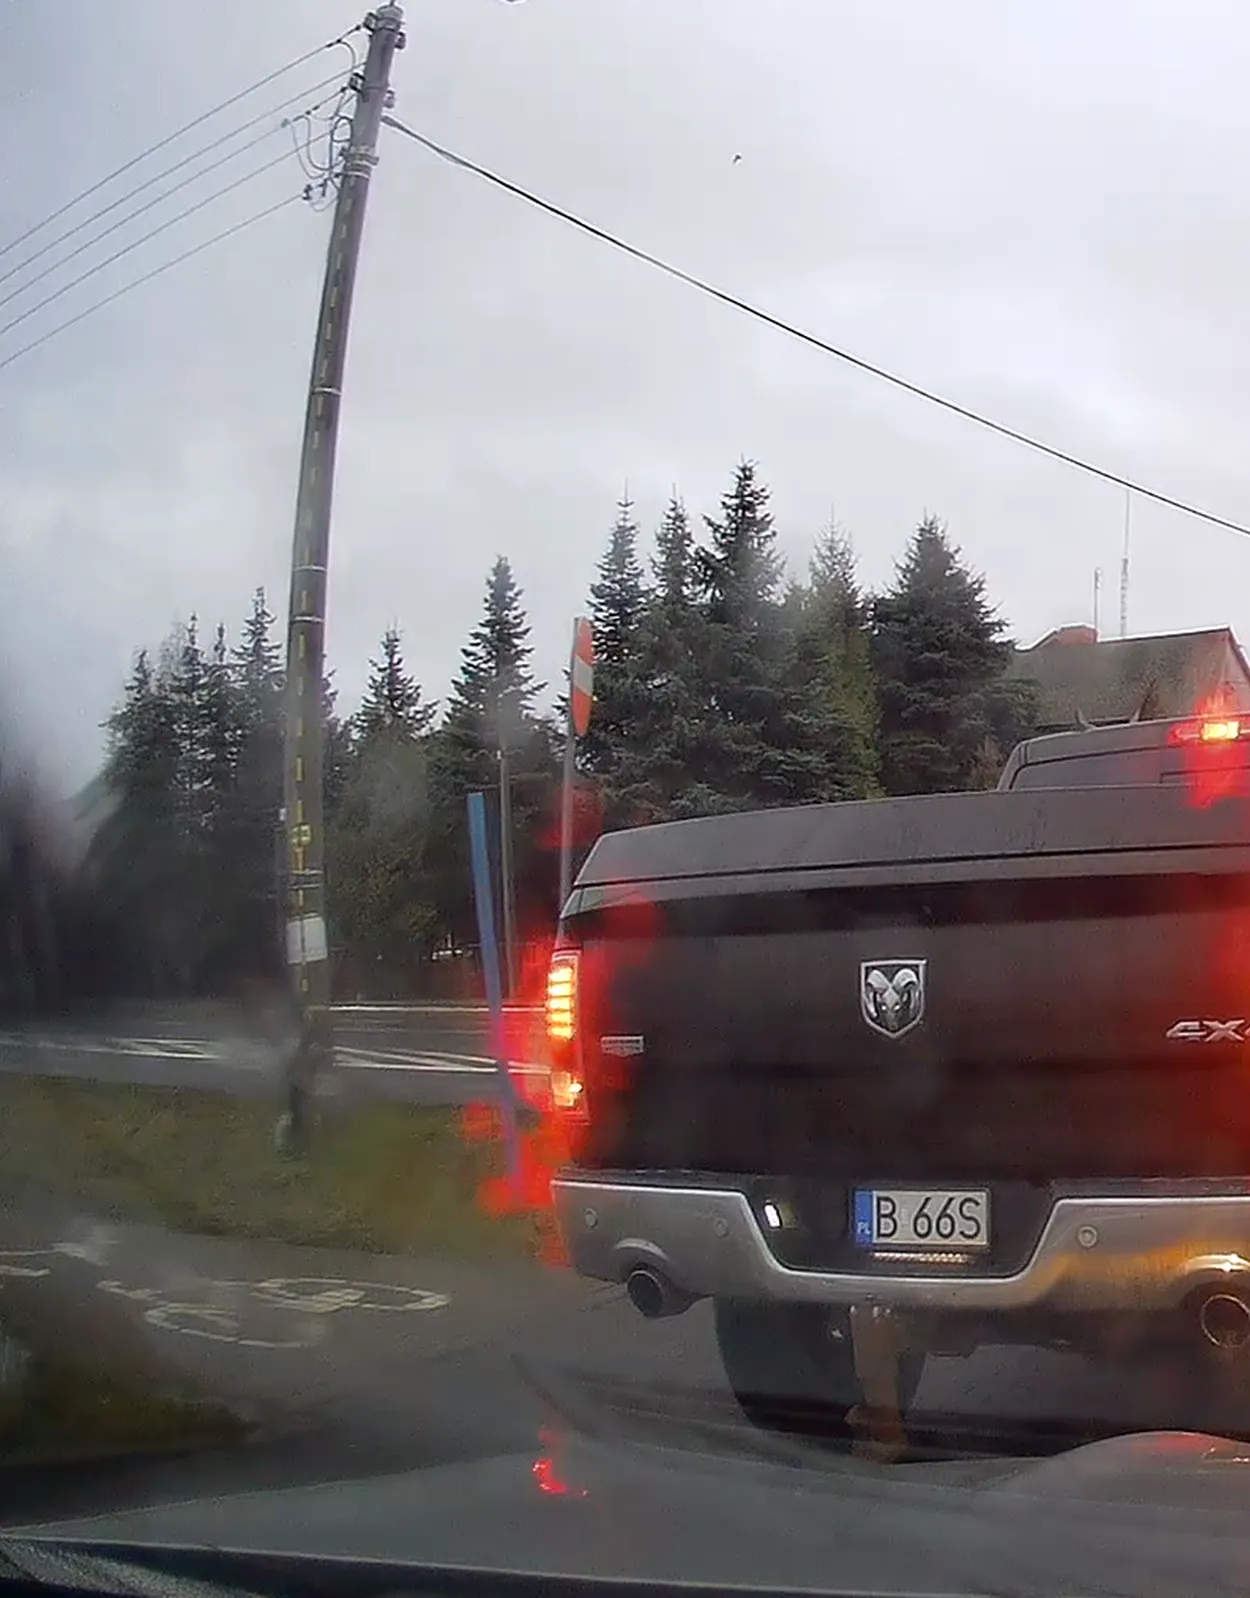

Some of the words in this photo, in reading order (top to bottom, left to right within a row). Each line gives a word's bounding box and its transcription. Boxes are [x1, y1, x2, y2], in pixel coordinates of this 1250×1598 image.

[857, 1221, 871, 1235] PL
[877, 1196, 898, 1238] B
[913, 1196, 981, 1239] 66S
